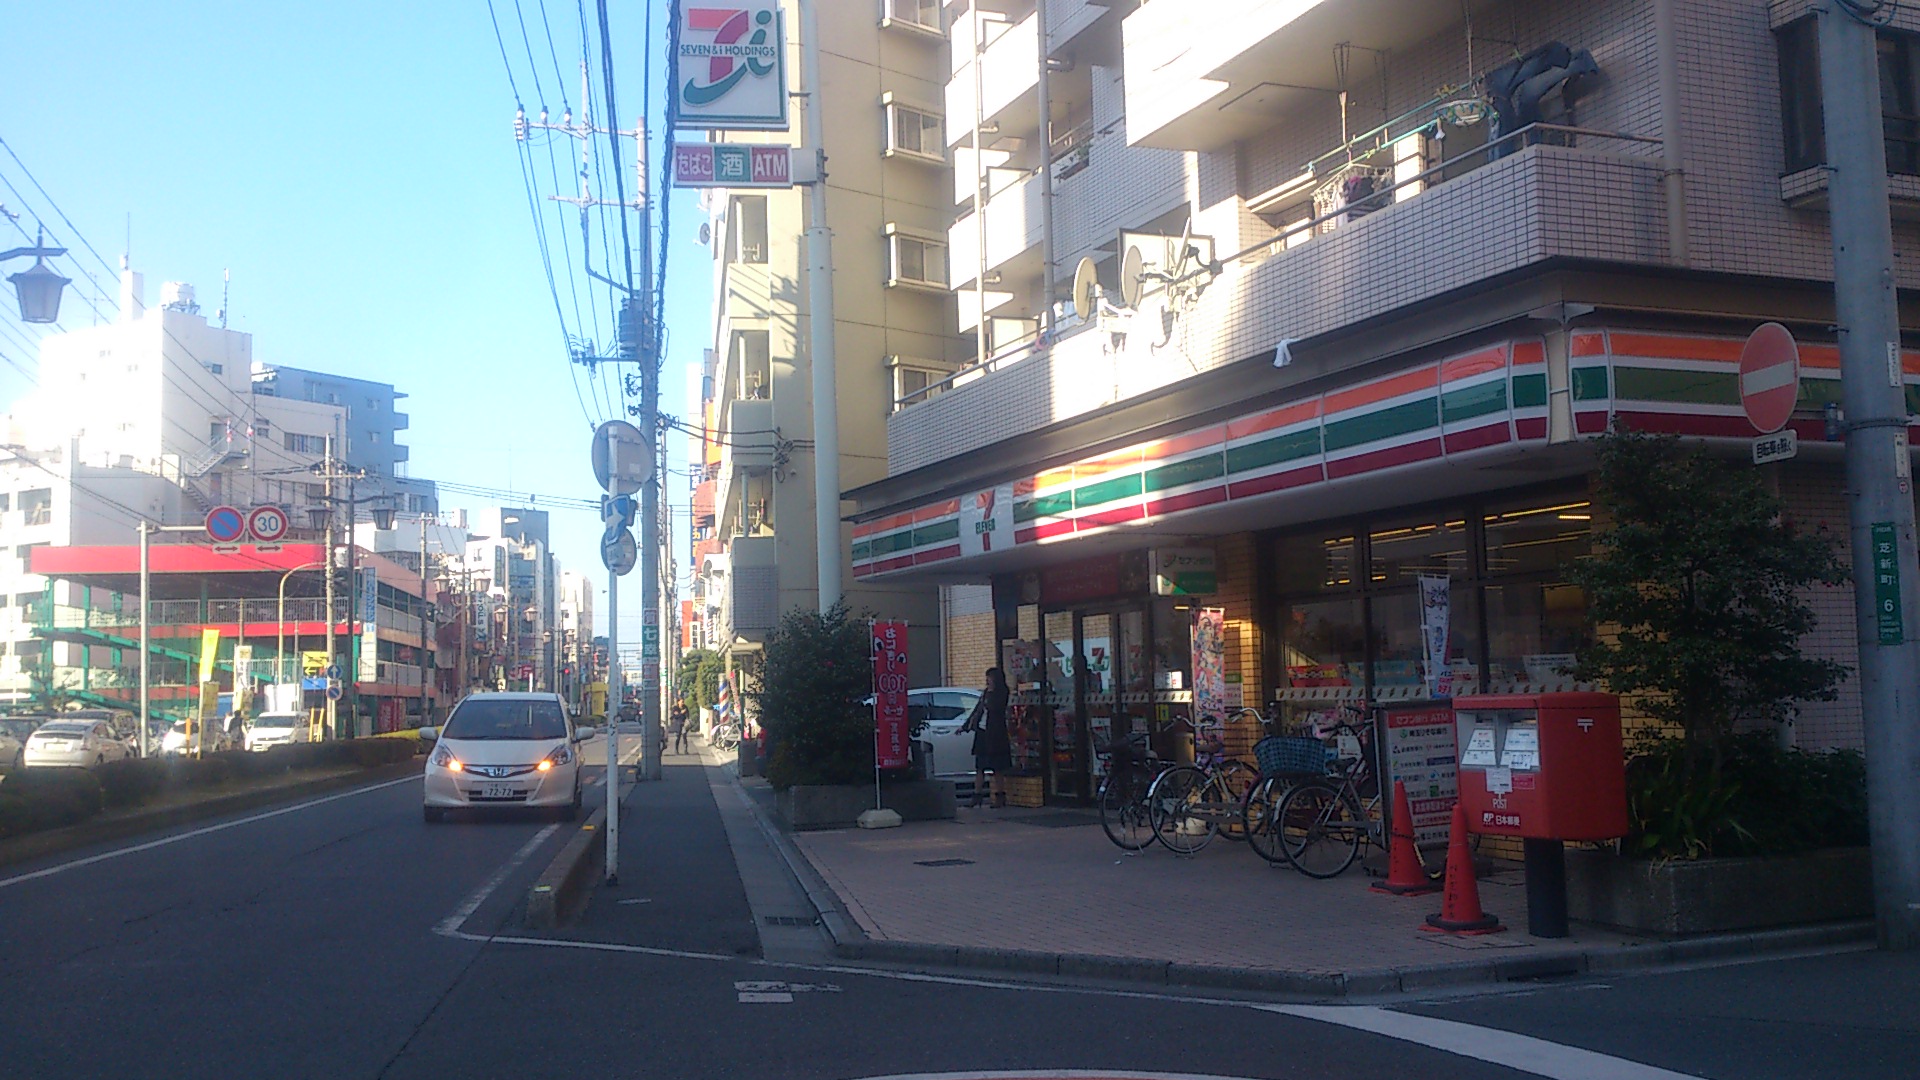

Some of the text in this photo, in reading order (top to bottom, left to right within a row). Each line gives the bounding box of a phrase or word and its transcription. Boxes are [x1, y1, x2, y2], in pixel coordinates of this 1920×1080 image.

[725, 45, 775, 57] HOLDINGS
[677, 153, 787, 177] たばこ 酒 ATM
[256, 515, 279, 533] 30
[975, 518, 995, 534] ELEVEN
[1879, 542, 1893, 586] 芝新町
[1884, 599, 1895, 613] 6
[1431, 713, 1449, 723] ATM
[1493, 798, 1507, 810] POST
[1496, 814, 1521, 827] 日本郵便
